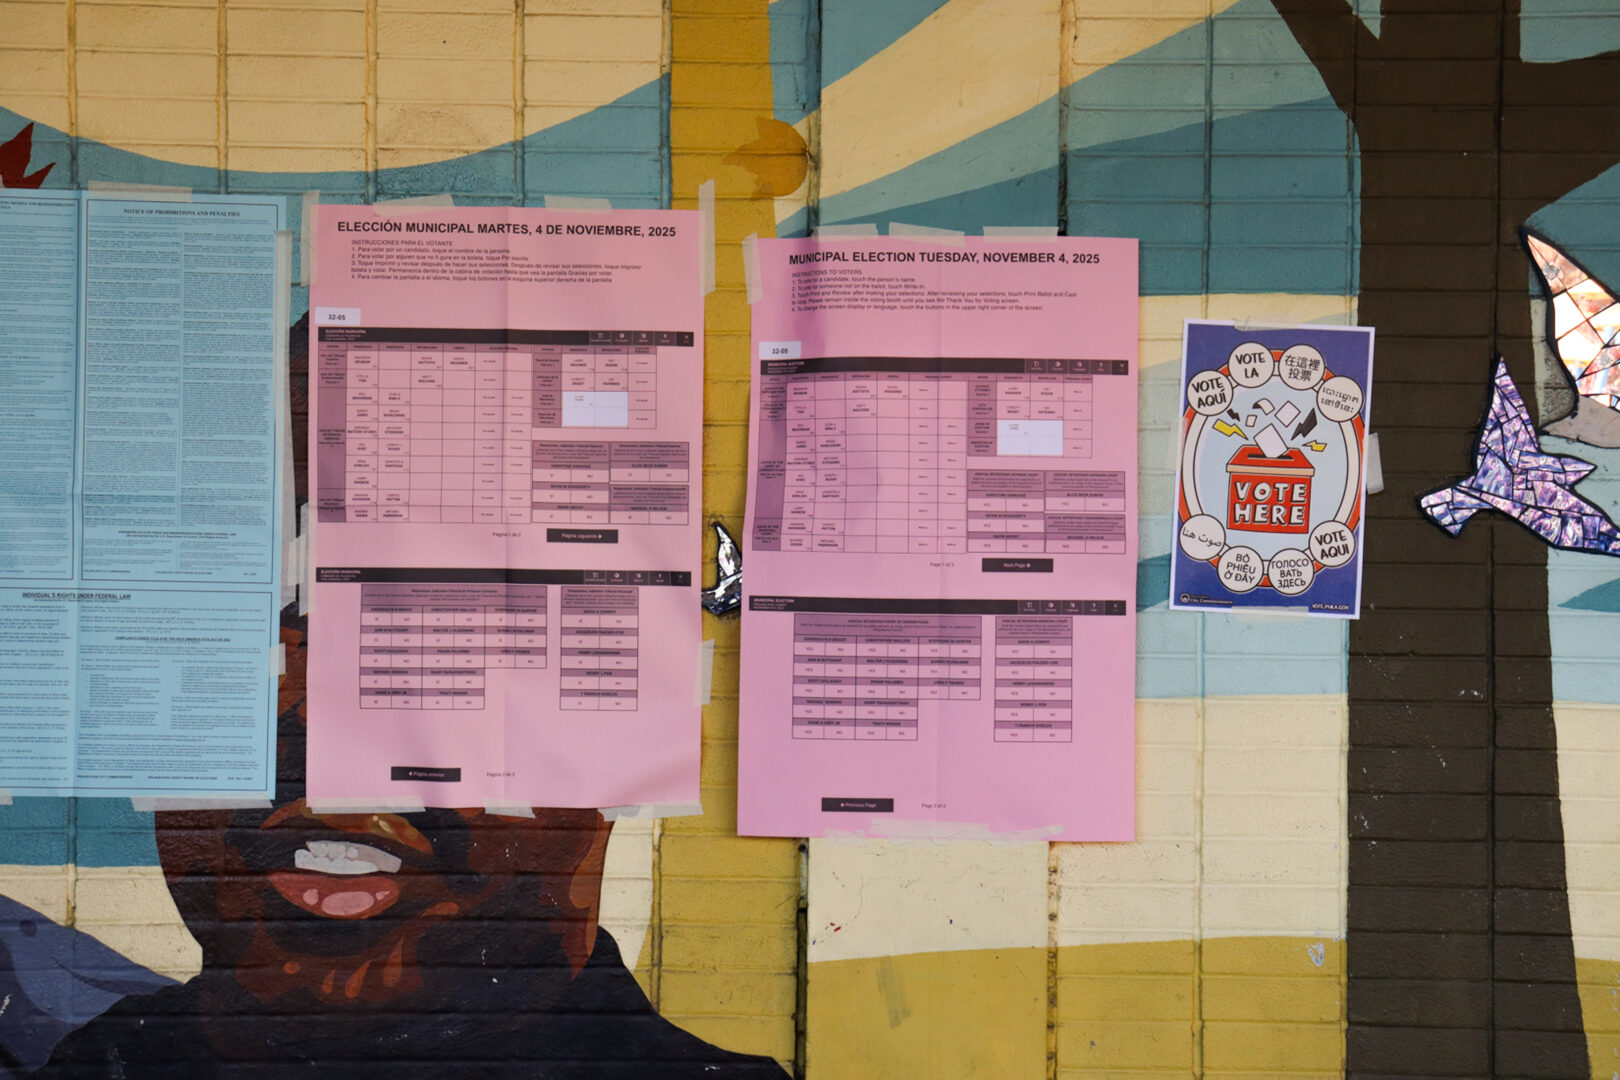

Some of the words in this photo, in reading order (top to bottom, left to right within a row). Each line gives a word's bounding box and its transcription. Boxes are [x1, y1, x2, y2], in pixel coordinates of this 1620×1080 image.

[338, 219, 402, 232] ELECCIÓN
[406, 222, 474, 234] MUNICIPAL
[478, 223, 531, 236] MARTES,
[536, 225, 543, 235] 4
[546, 225, 563, 235] DE
[567, 225, 645, 238] NOVIEMBRE,
[648, 226, 677, 237] 2025
[790, 252, 848, 264] MUNICIPAL
[853, 252, 915, 262] ELECTION
[920, 252, 979, 265] TUESDAY,
[984, 252, 1055, 263] NOVEMBER
[1058, 253, 1068, 265] 4,
[1072, 254, 1100, 264] 2025
[1235, 352, 1265, 365] VOTE
[1285, 354, 1321, 372] 在這裡
[1245, 367, 1259, 379] LA
[1288, 369, 1312, 382] 投票
[1192, 377, 1224, 393] VOTE
[1197, 389, 1227, 408] AQUÍ
[1234, 481, 1307, 504] VOTE
[1234, 503, 1306, 525] HERE
[1182, 527, 1196, 539] هنا
[1315, 529, 1347, 546] VOTE
[1199, 534, 1222, 547] صوت
[1320, 543, 1349, 560] AQUI
[1003, 561, 1013, 569] Next
[1014, 561, 1026, 570] Page
[1271, 558, 1310, 569] ГОЛОСО
[1280, 570, 1303, 579] ВАТЬ
[1277, 579, 1306, 590] ЗДЕСЬ
